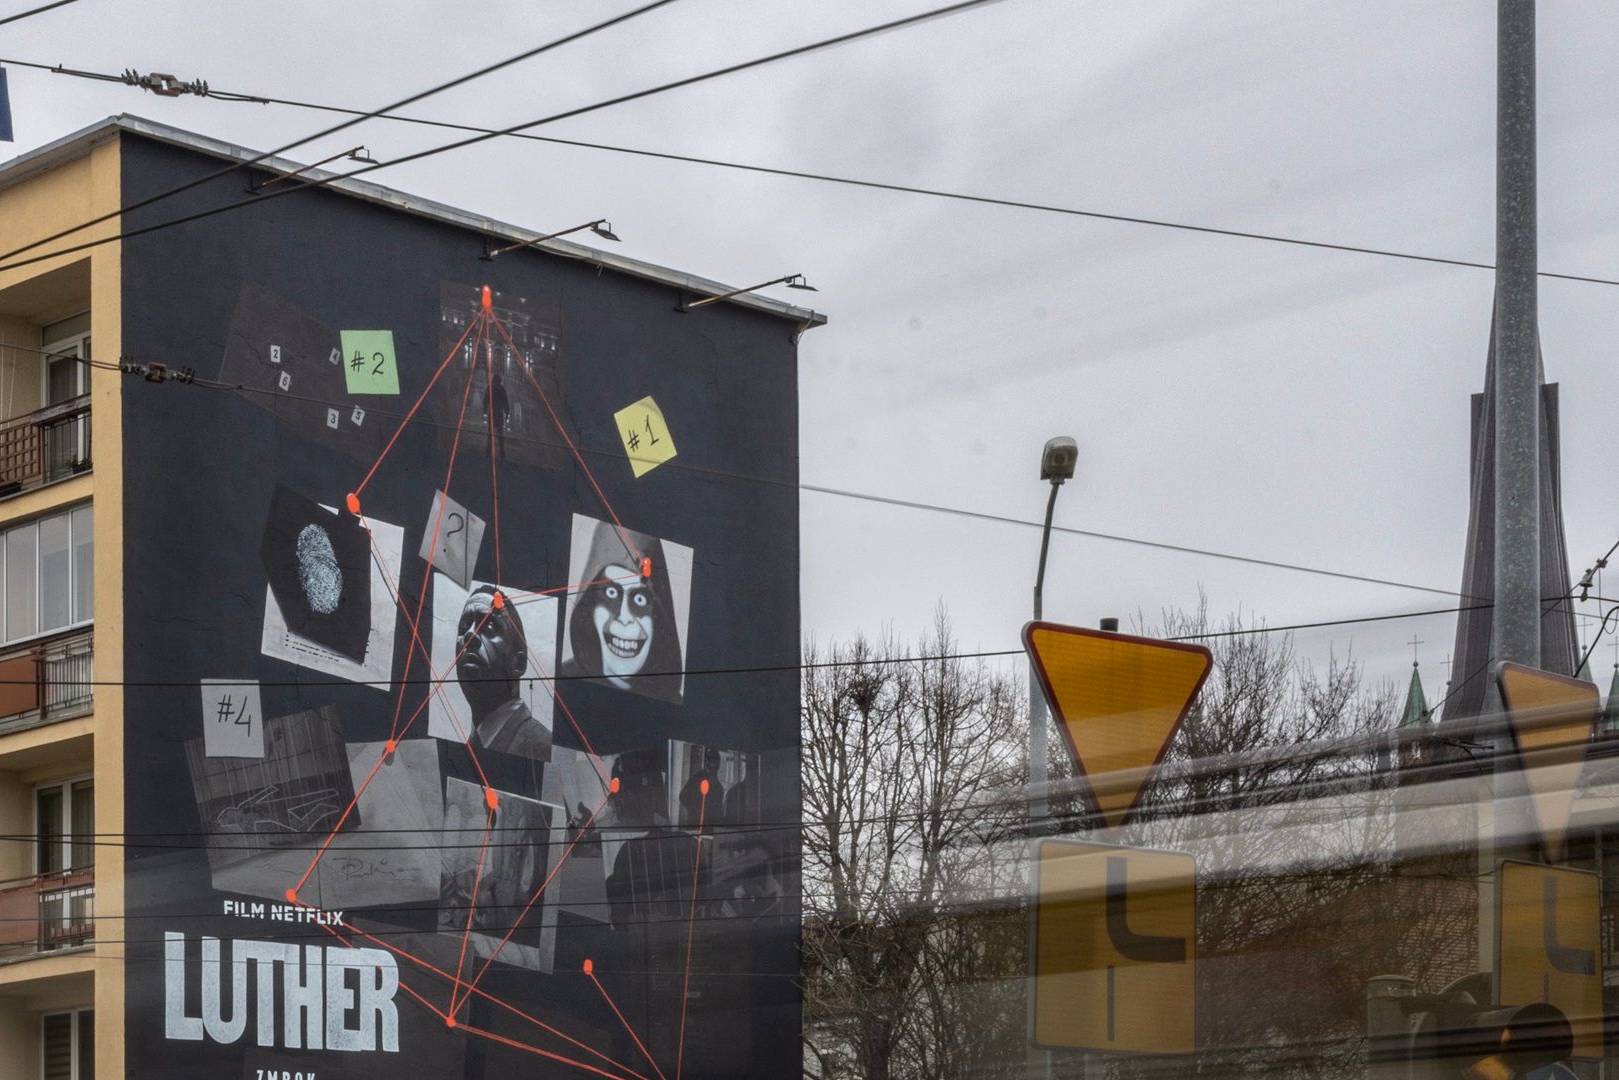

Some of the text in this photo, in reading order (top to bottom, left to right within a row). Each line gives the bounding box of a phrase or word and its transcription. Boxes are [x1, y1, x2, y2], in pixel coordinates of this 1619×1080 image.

[217, 694, 252, 738] #4
[223, 900, 344, 927] FILM NETFLIX
[164, 931, 400, 1053] LUTHER
